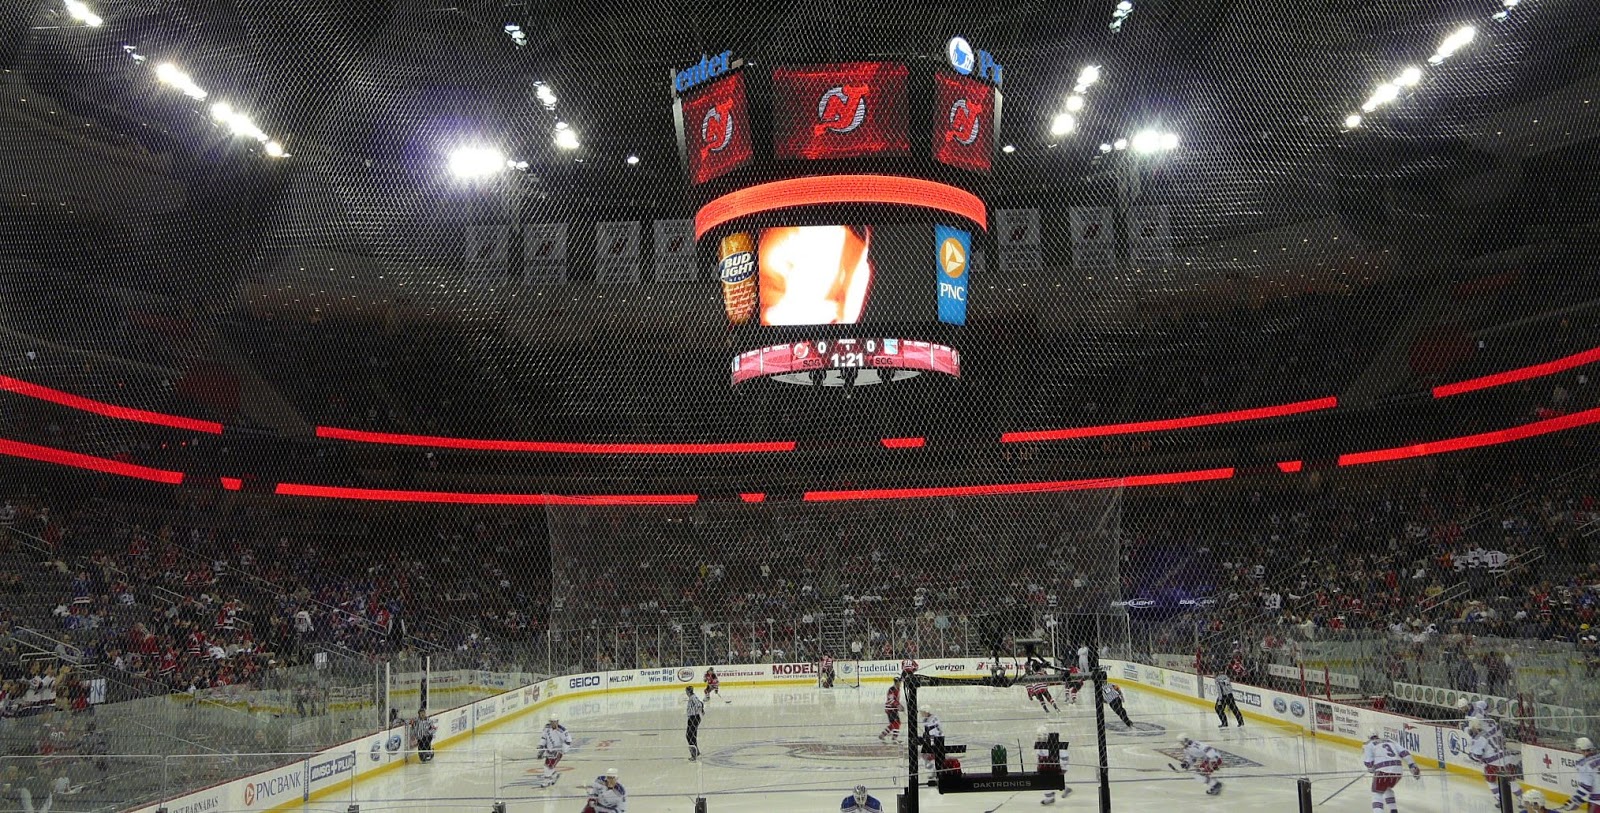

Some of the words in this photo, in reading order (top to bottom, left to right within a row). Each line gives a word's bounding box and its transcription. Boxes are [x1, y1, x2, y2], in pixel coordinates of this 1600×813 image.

[724, 253, 751, 268] BUD
[721, 261, 755, 279] LIGHT
[940, 282, 964, 301] PNC
[817, 341, 827, 354] 0
[866, 340, 875, 352] 0
[831, 353, 864, 367] 1:21
[662, 668, 675, 676] Big!
[935, 663, 965, 672] verizon
[569, 676, 600, 689] GEICO
[1398, 730, 1420, 753] WFAN
[1382, 744, 1396, 757] 3
[1561, 757, 1577, 768] PLEA
[973, 780, 1032, 789] DAKTRONICS
